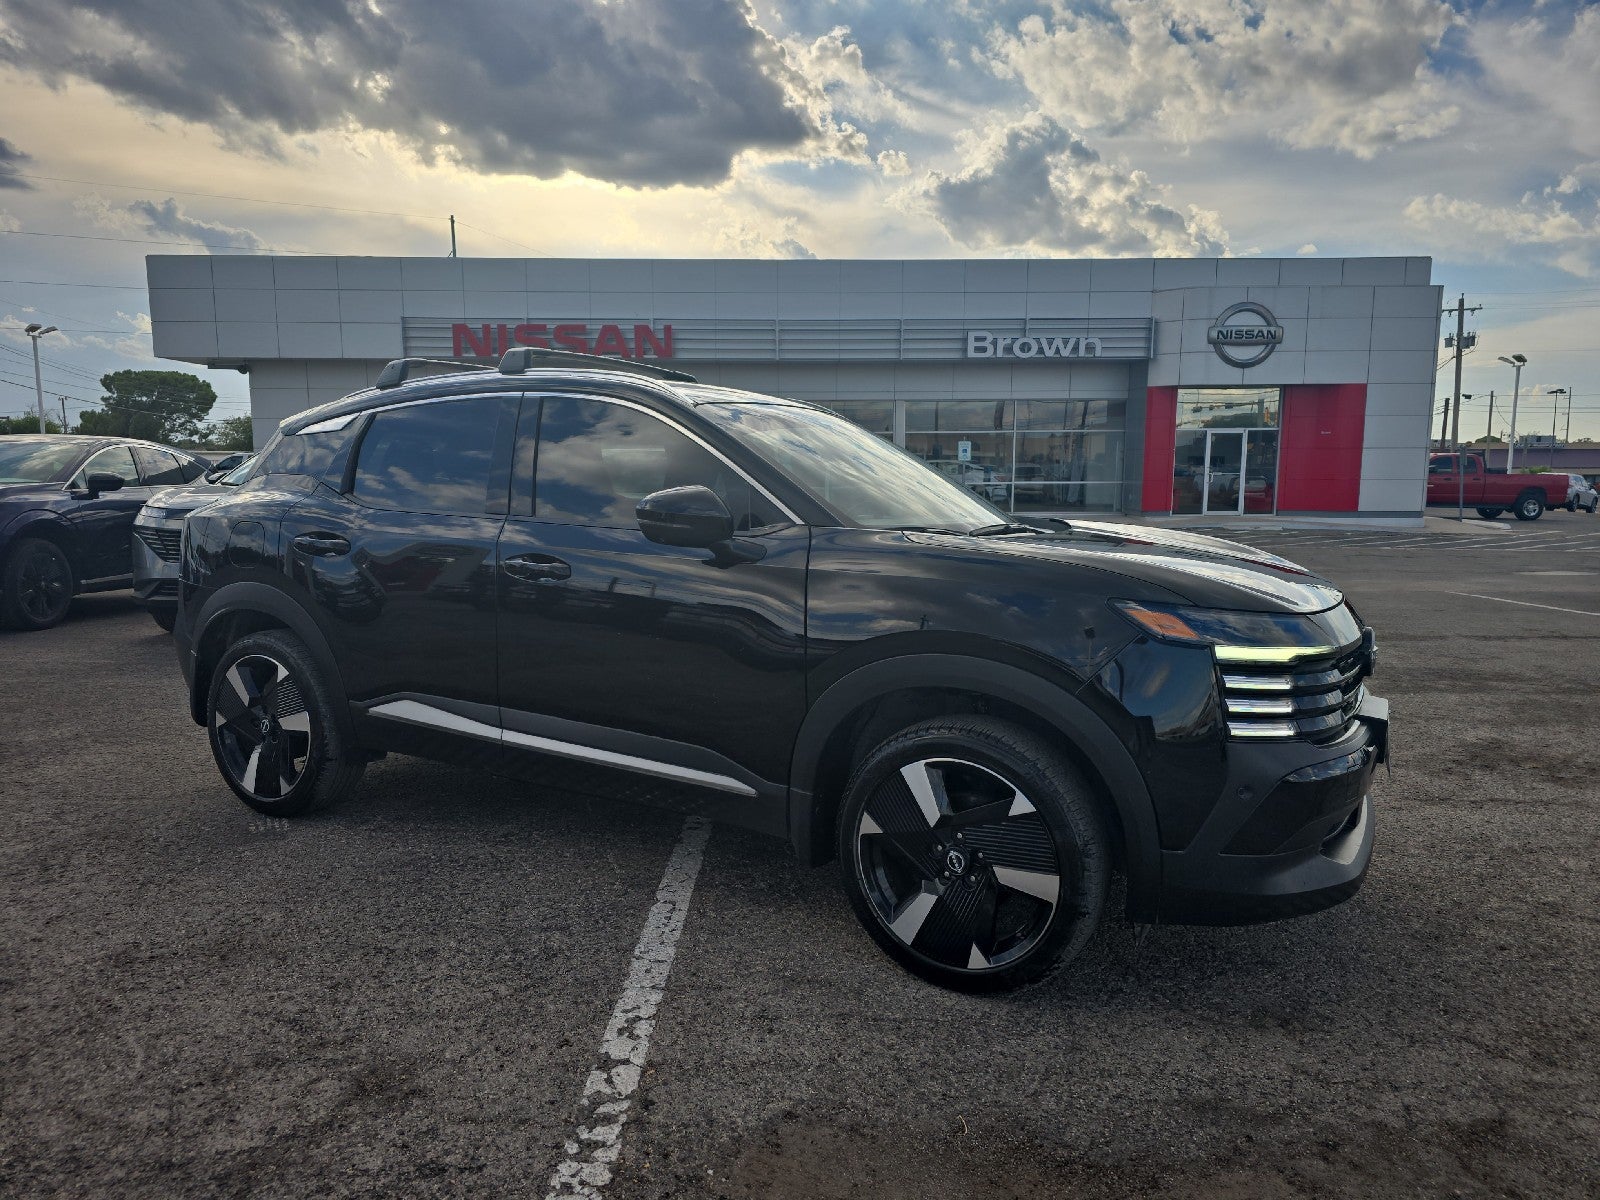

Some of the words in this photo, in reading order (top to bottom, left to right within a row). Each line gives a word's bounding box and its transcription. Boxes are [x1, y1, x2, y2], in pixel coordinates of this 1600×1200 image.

[452, 323, 673, 359] NISSAN
[967, 331, 1102, 358] Brown
[1217, 329, 1277, 340] NISSAN
